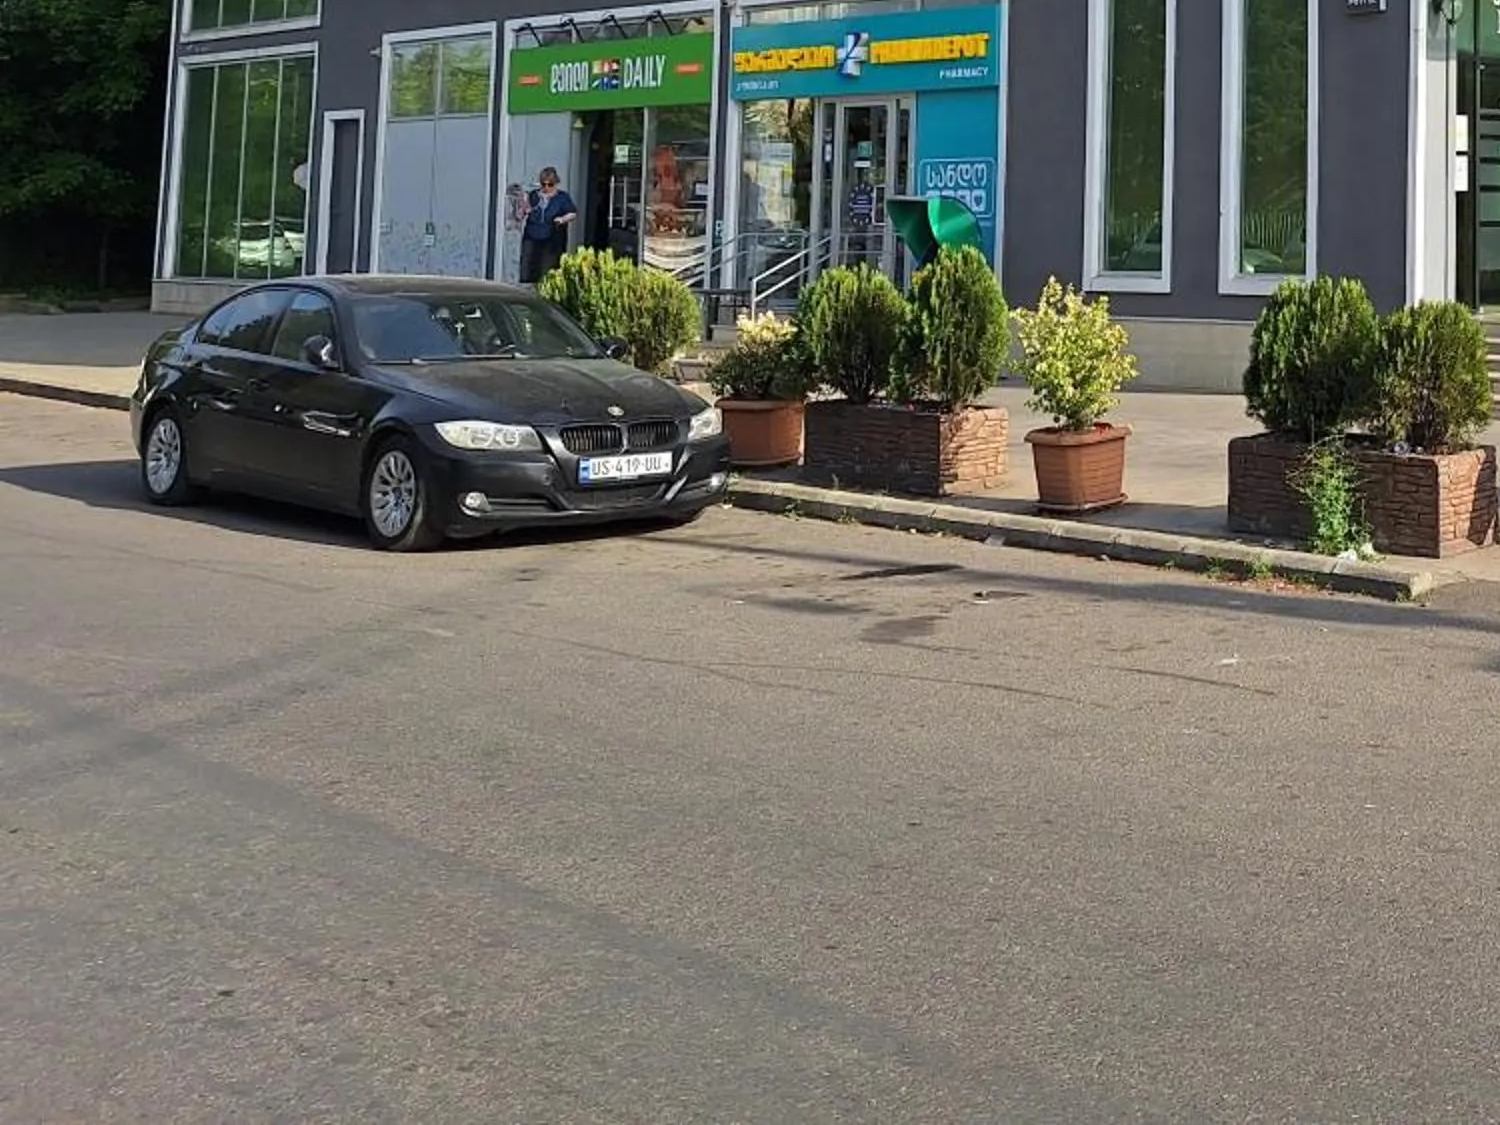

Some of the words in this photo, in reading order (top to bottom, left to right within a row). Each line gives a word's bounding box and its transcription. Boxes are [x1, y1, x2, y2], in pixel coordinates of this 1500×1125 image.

[623, 54, 667, 89] DAILY
[939, 66, 989, 79] PHARMACY
[926, 162, 987, 187] სანდო
